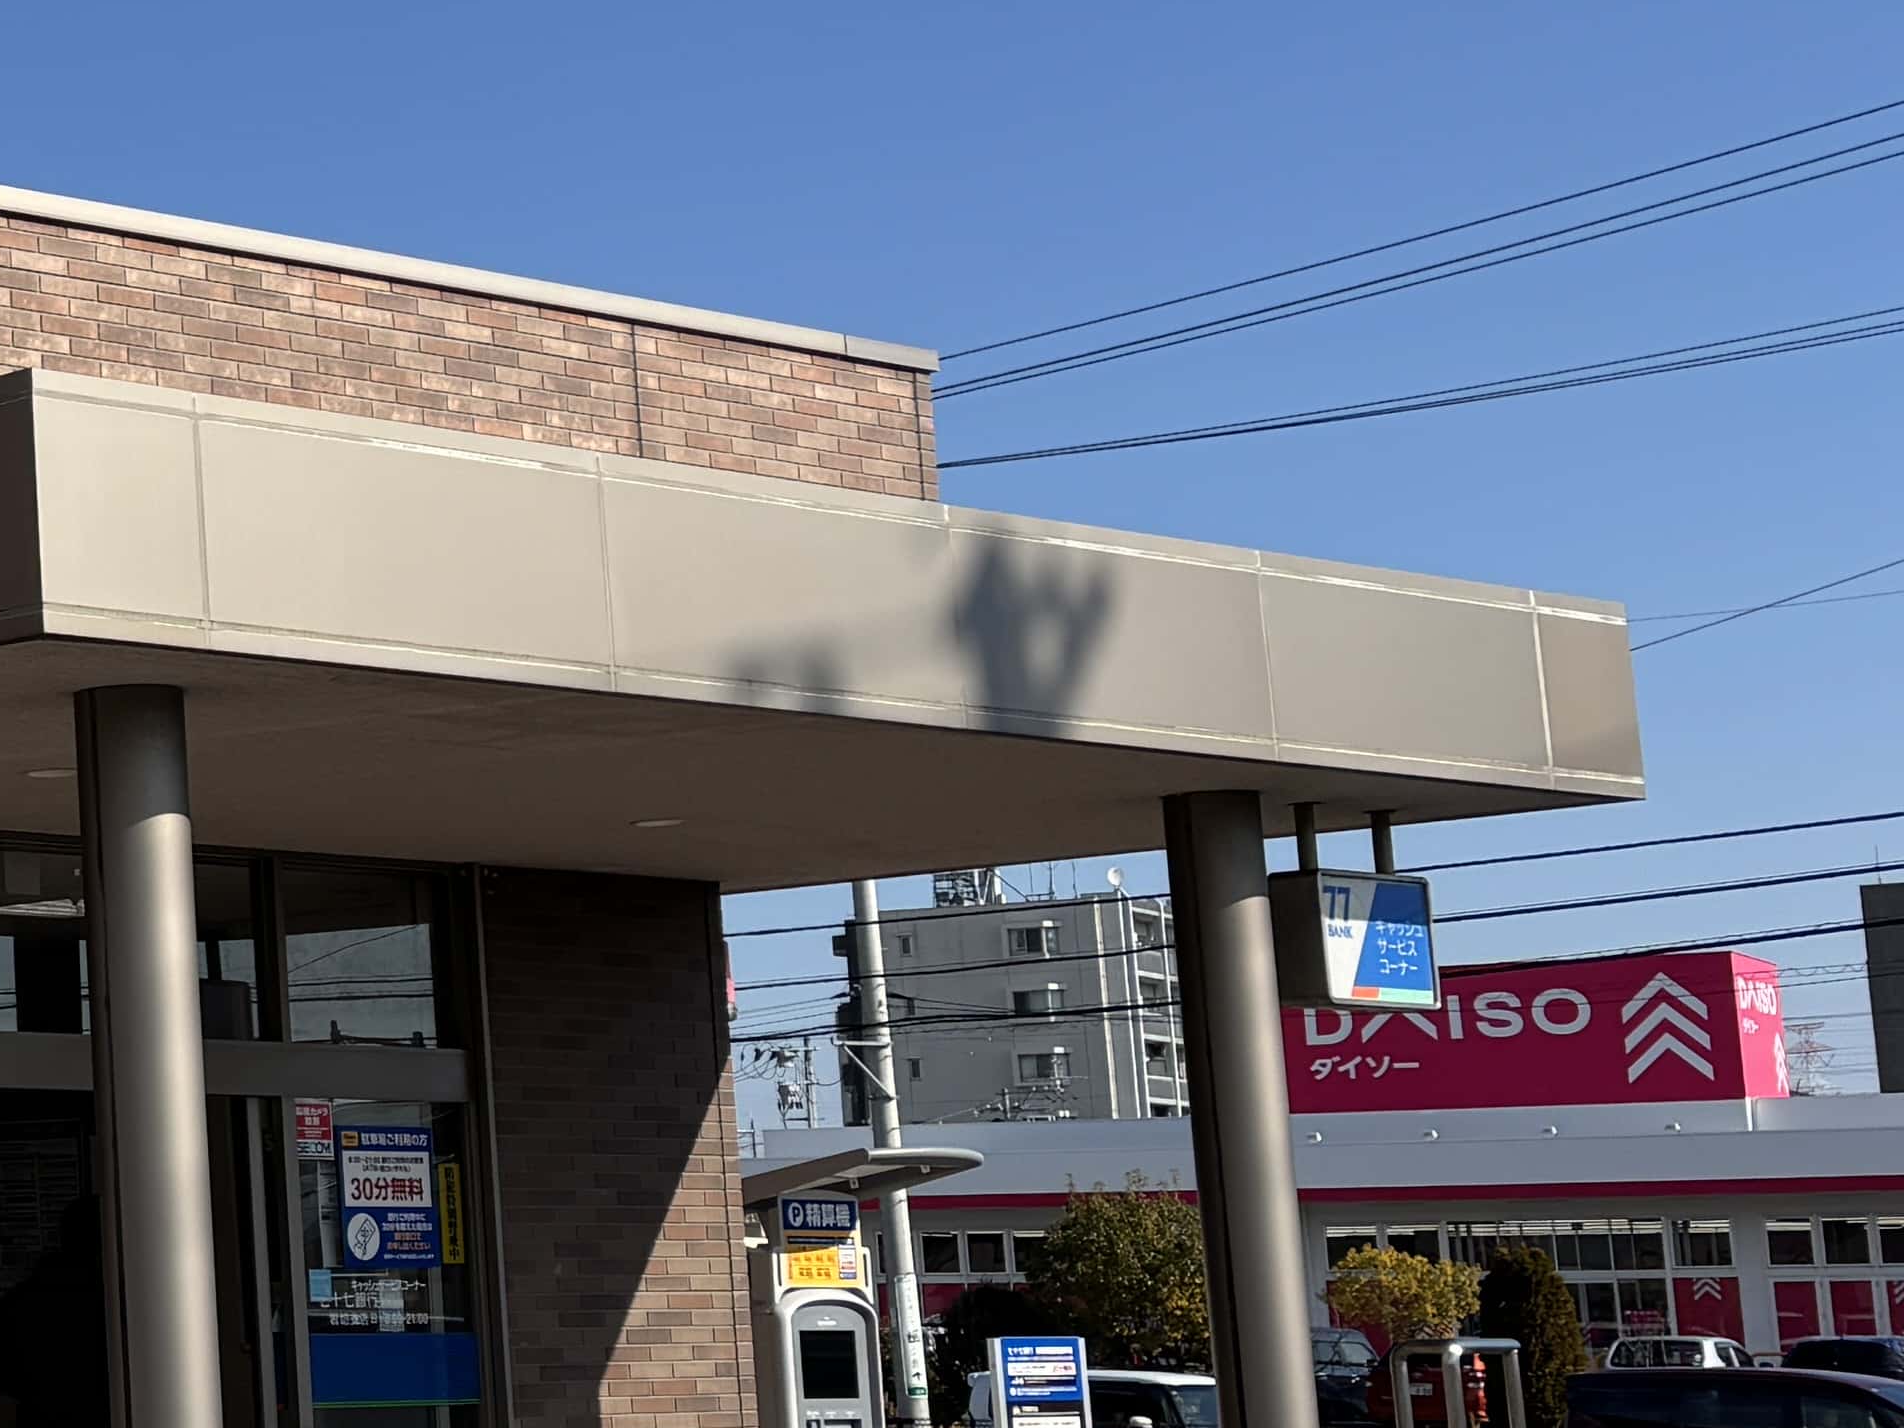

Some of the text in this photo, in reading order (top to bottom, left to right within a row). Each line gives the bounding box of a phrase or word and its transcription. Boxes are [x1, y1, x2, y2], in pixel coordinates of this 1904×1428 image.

[1323, 886, 1351, 922] 77
[1328, 924, 1353, 939] BANK
[1375, 921, 1424, 938] キャッシュ
[1377, 940, 1418, 956] サービス
[1379, 959, 1418, 975] コーナー
[1737, 976, 1778, 1015] DAISO
[1303, 988, 1592, 1046] DAISO
[1310, 1055, 1420, 1080] ダイソー
[351, 1177, 425, 1202] 30分無料
[805, 1203, 851, 1227] 精算機
